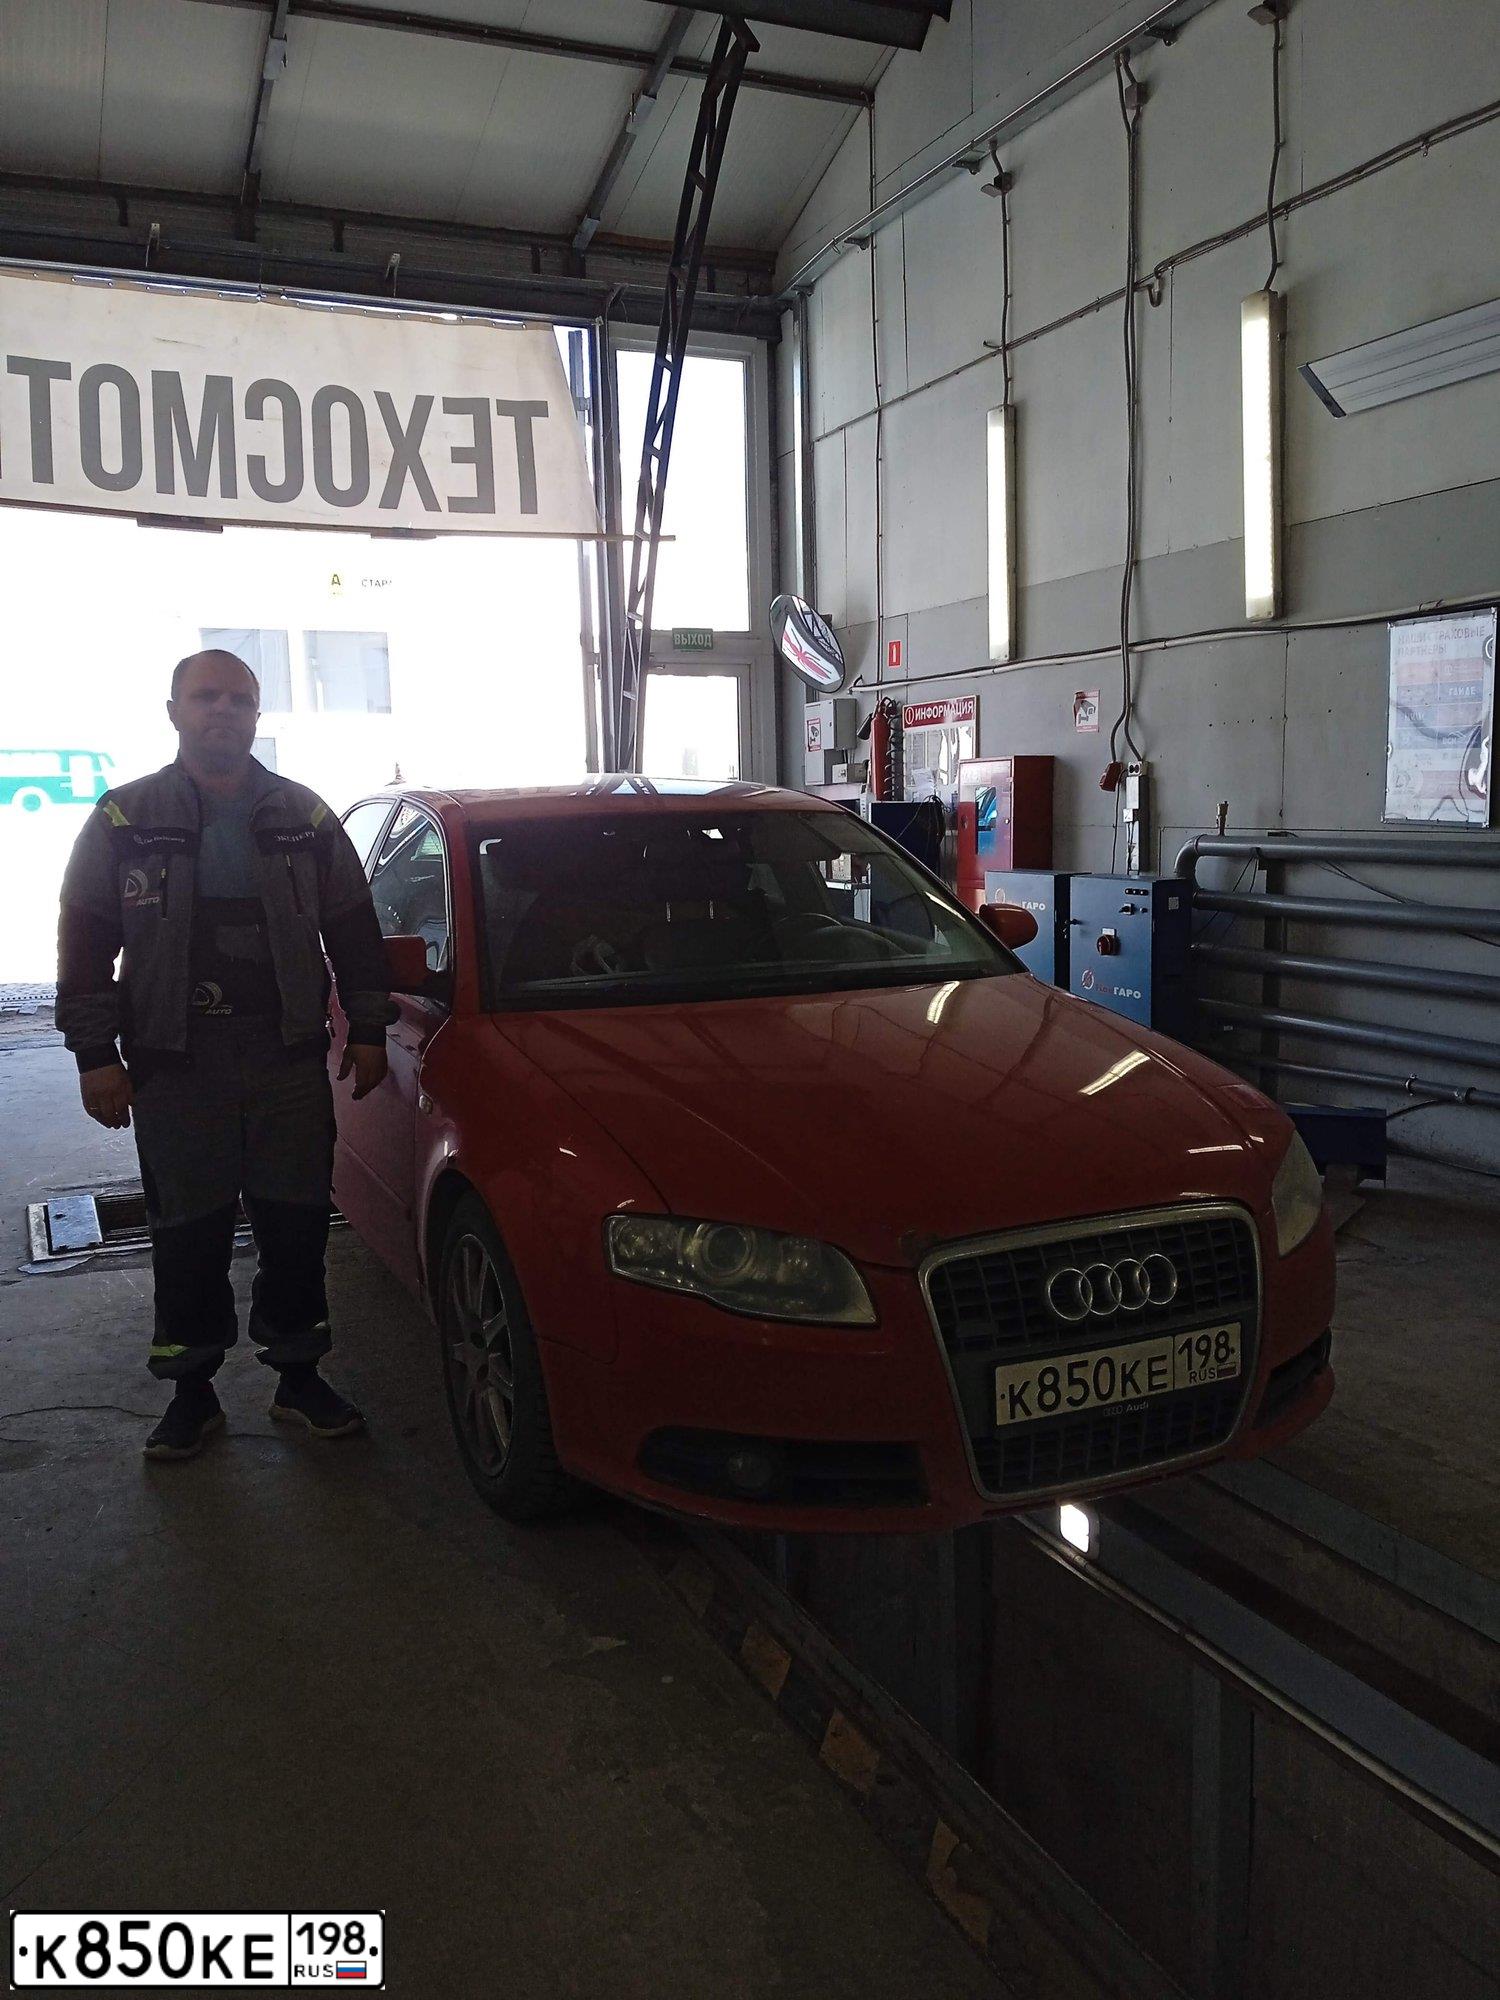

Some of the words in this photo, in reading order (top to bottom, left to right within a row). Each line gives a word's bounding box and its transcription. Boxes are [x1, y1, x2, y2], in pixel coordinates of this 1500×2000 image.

[673, 633, 712, 647] ВЫХОД
[914, 700, 975, 721] ИНФОРМАЦИЯ
[1008, 1355, 1168, 1420] К850КЕ
[1177, 1330, 1231, 1371] 198
[1188, 1368, 1216, 1385] RUS
[1126, 1402, 1149, 1413] Audi
